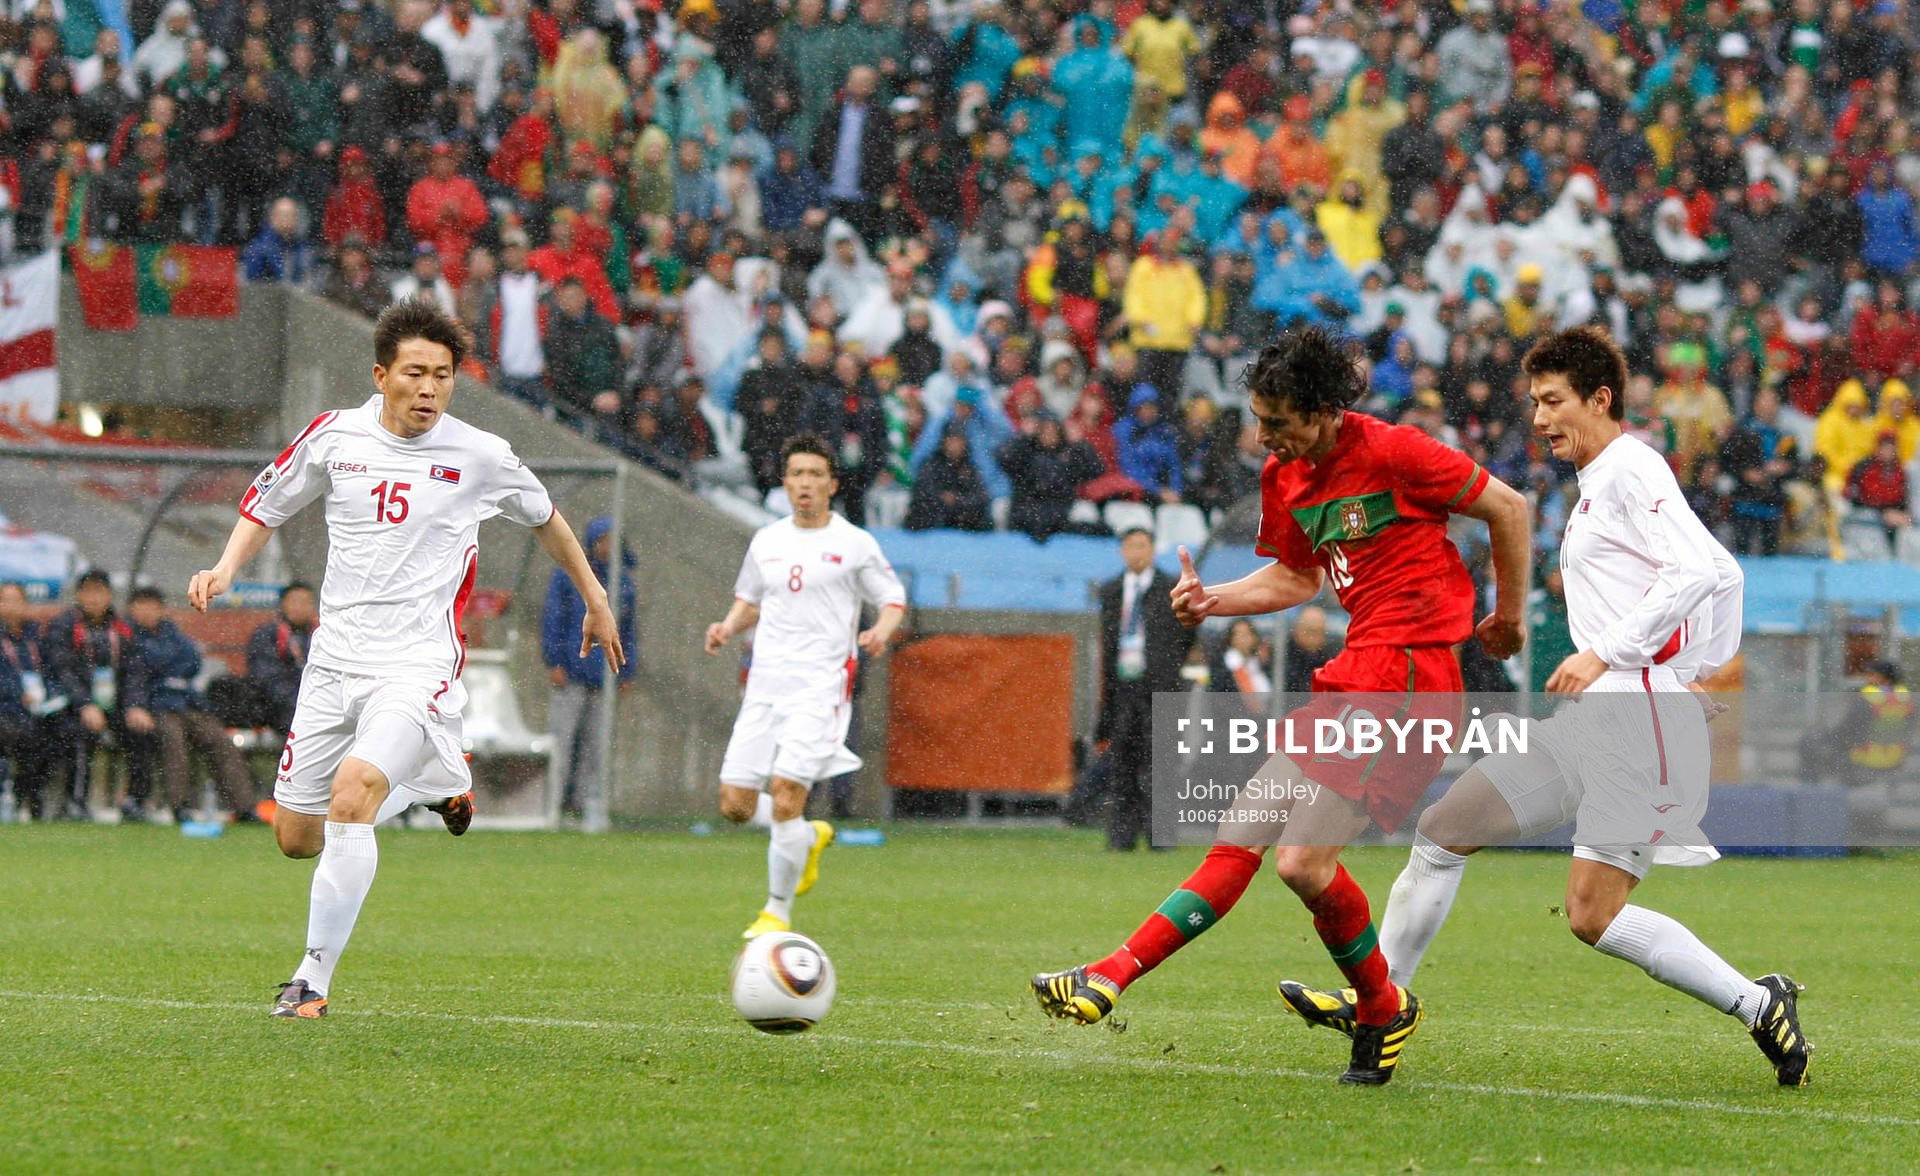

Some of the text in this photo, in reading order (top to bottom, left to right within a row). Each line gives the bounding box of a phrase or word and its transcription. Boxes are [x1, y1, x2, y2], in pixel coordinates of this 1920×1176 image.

[332, 461, 368, 473] LEGEA
[371, 480, 411, 524] 15
[789, 564, 803, 592] 8
